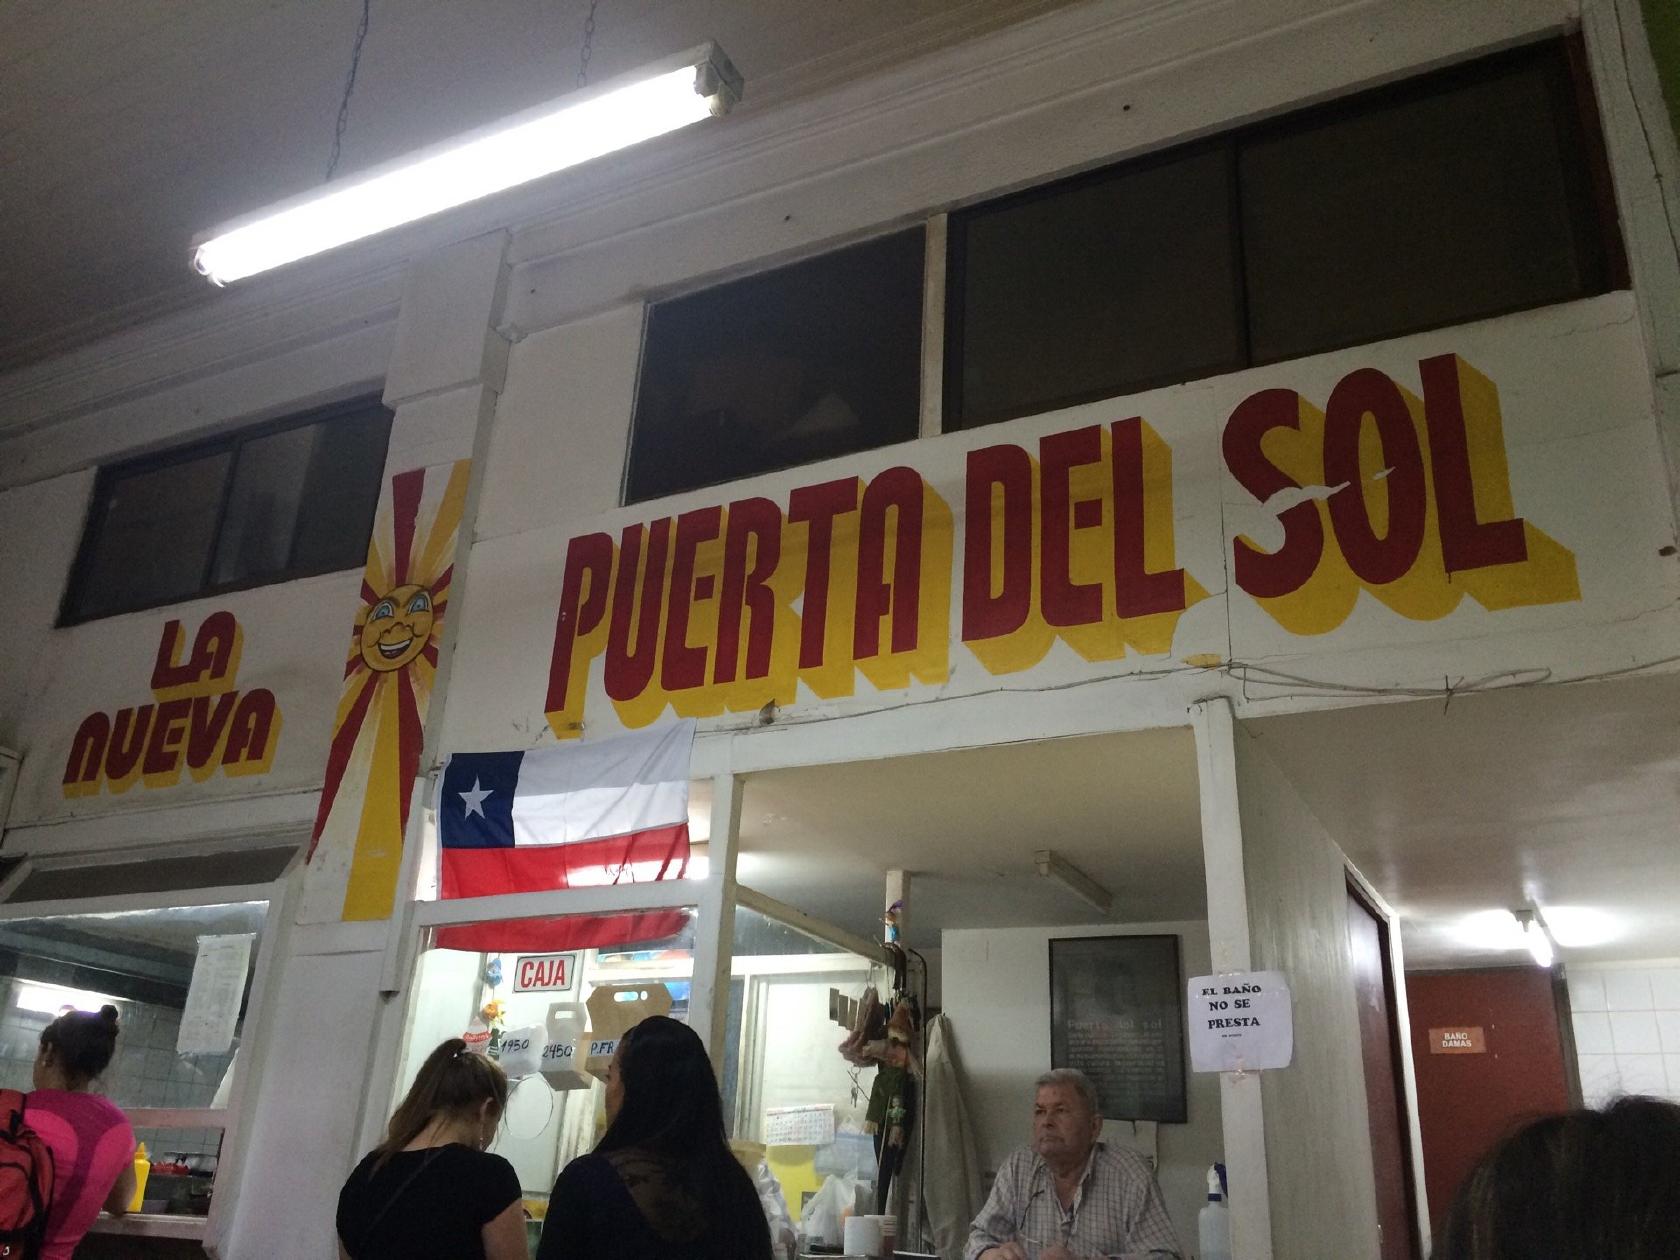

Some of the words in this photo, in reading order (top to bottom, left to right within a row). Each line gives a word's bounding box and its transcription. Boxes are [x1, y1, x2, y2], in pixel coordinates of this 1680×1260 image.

[544, 466, 925, 714] PUERTA
[962, 415, 1186, 642] DEL
[1222, 353, 1528, 606] SOL
[150, 610, 237, 690] LA
[62, 687, 277, 786] NUEVA
[520, 959, 566, 988] CAJA
[1201, 987, 1218, 996] EL
[1223, 982, 1262, 995] BAÑO
[1208, 1000, 1229, 1011] NO
[1234, 998, 1251, 1009] SE
[1207, 1016, 1261, 1030] PRESTA
[500, 1039, 530, 1053] 1950
[1441, 1039, 1472, 1048] DAMAS
[542, 1045, 573, 1059] 2450
